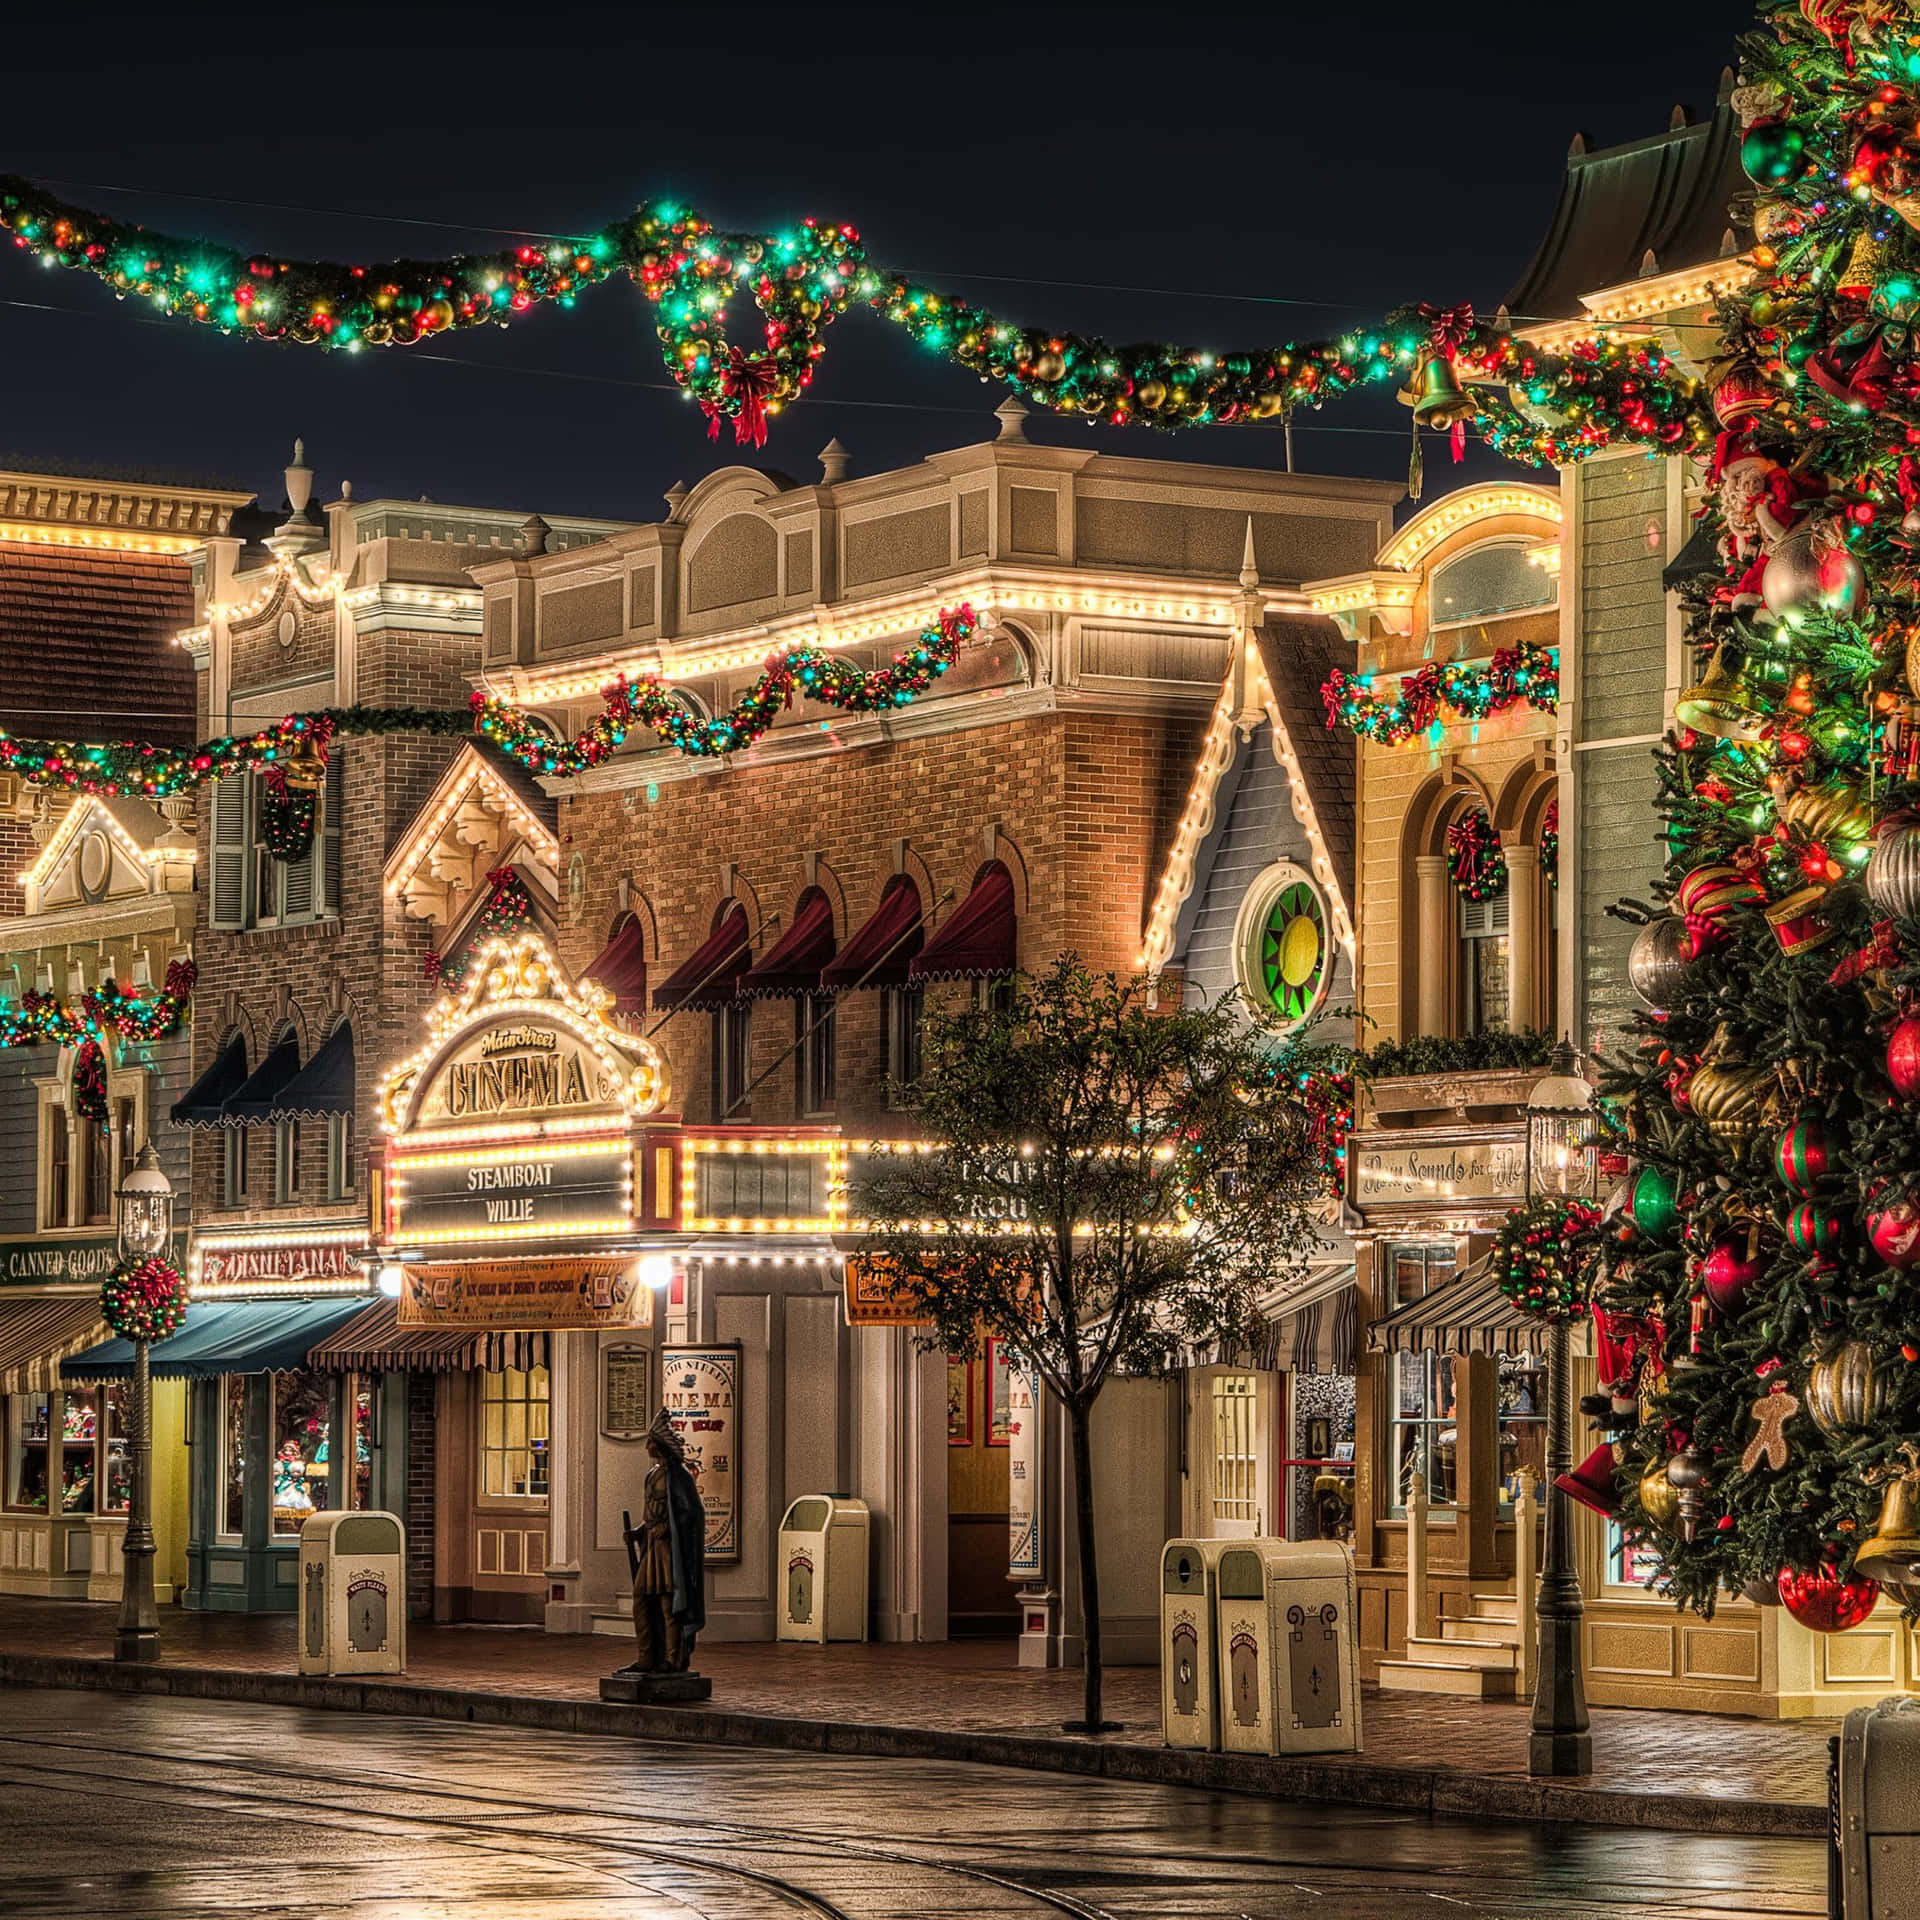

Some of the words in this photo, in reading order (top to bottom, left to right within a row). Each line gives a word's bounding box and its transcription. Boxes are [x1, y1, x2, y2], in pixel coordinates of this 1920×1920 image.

[482, 1029, 517, 1056] Main
[517, 1023, 556, 1049] Street
[449, 1050, 591, 1116] CINEMA
[467, 1164, 553, 1191] STEAMBOAT
[1404, 1150, 1464, 1192] Sounds
[1469, 1159, 1485, 1179] for
[1495, 1147, 1524, 1187] Ne
[486, 1198, 534, 1222] WILLIE
[10, 1251, 63, 1277] CANNED
[67, 1248, 113, 1275] GOODS
[225, 1249, 330, 1283] DISNEYANA
[664, 1393, 732, 1408] INEMA
[712, 1455, 729, 1465] SIX
[1012, 1460, 1025, 1472] SIX
